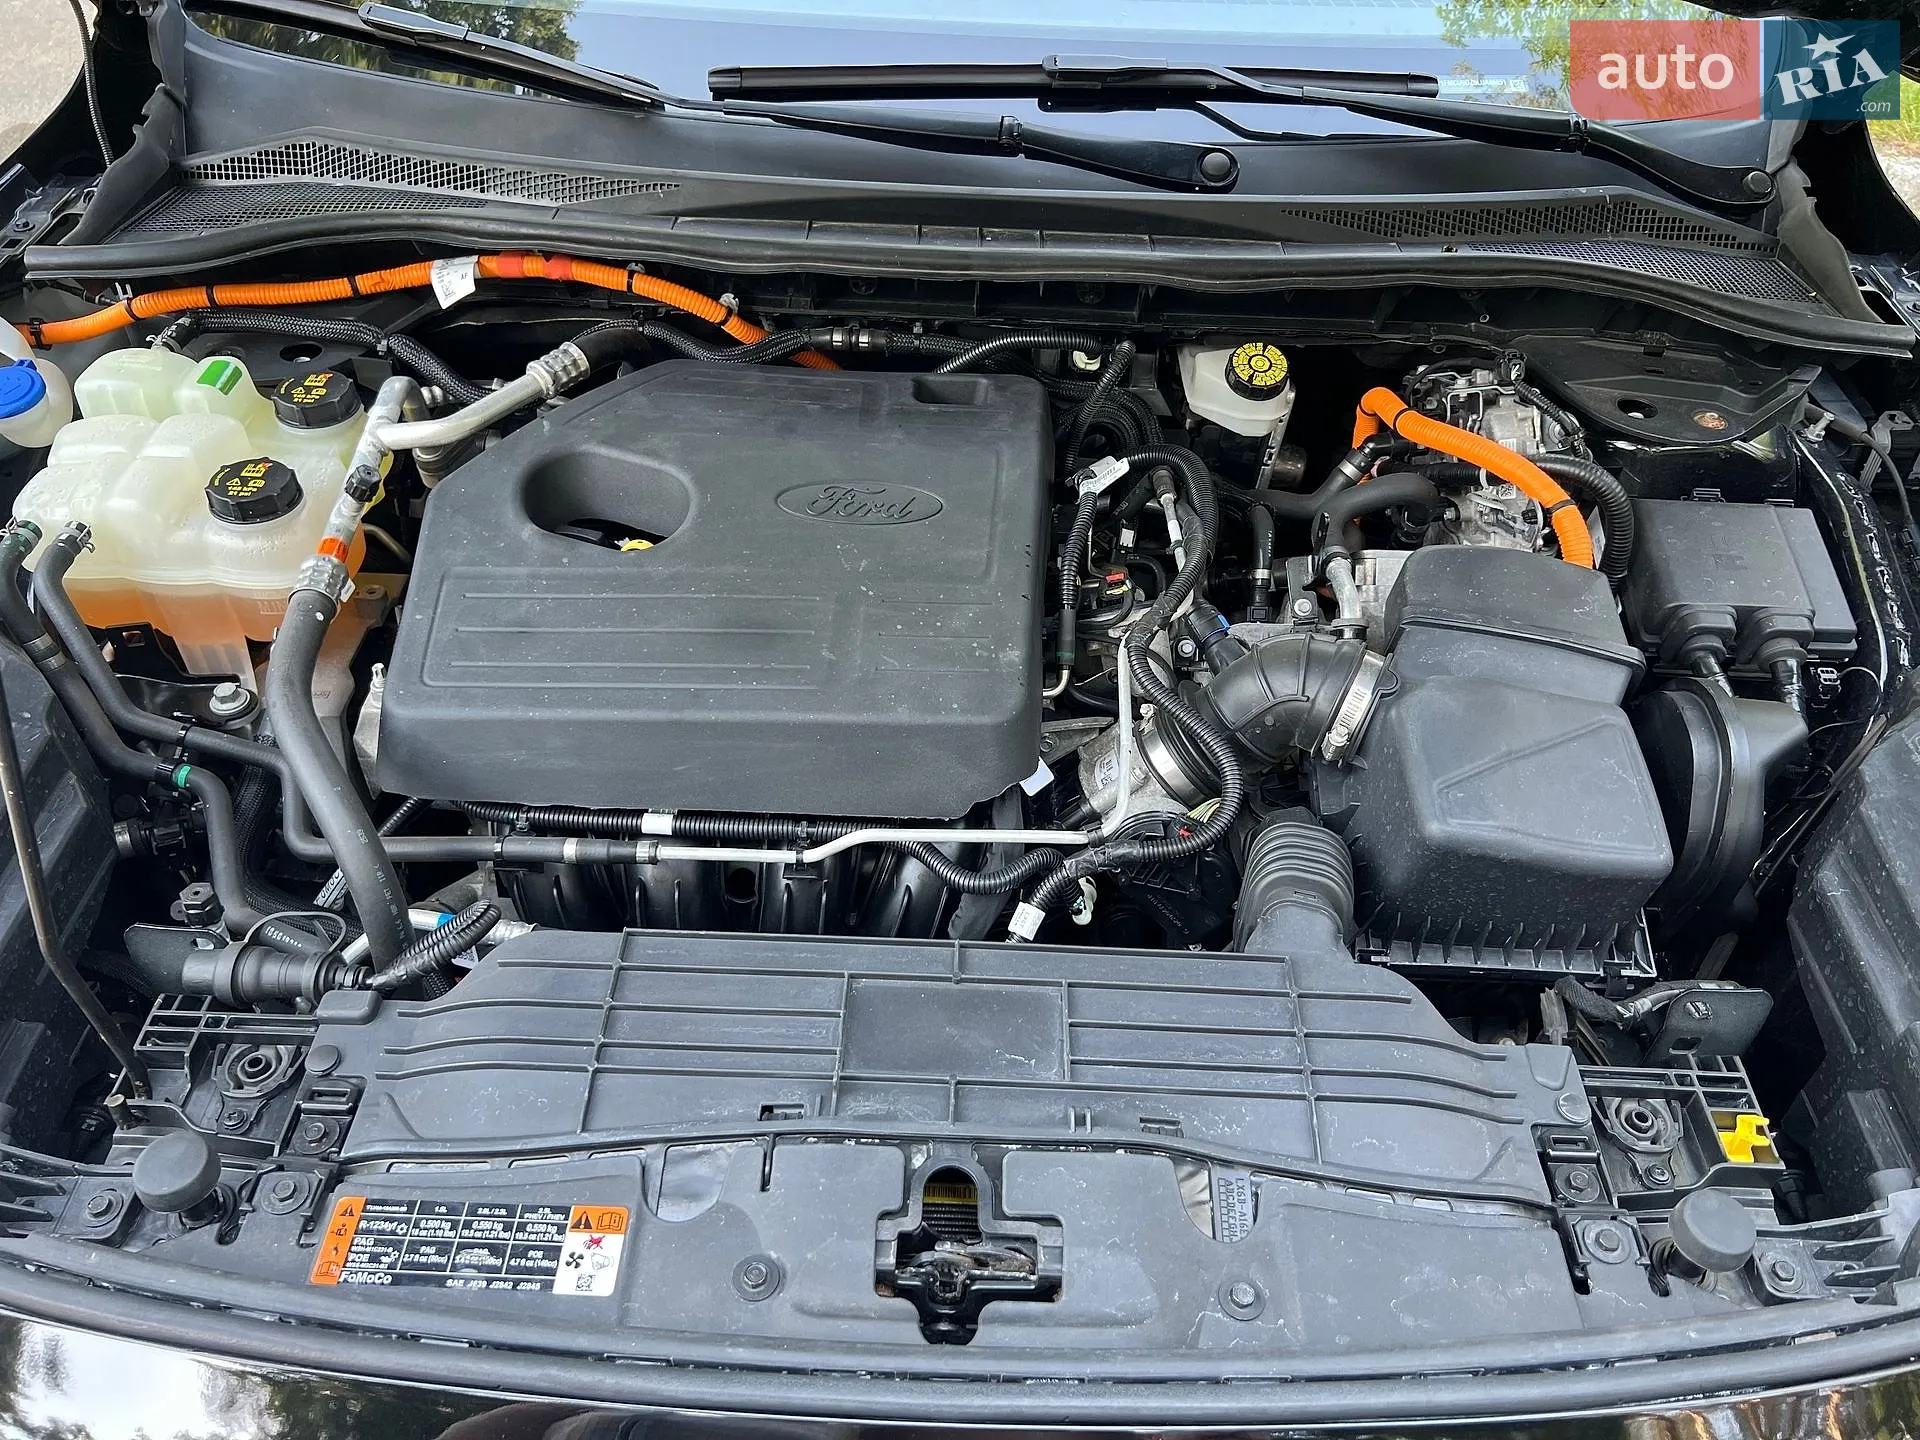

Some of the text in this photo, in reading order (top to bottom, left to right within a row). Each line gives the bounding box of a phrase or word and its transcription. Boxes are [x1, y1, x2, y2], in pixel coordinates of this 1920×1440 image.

[806, 485, 917, 520] Ford
[441, 1220, 452, 1230] kg
[493, 1221, 504, 1231] kg
[547, 1224, 558, 1234] kg
[353, 1237, 375, 1246] PAG
[348, 1252, 370, 1262] POE
[340, 1271, 393, 1285] FoMoCo
[445, 1278, 465, 1287] SAE
